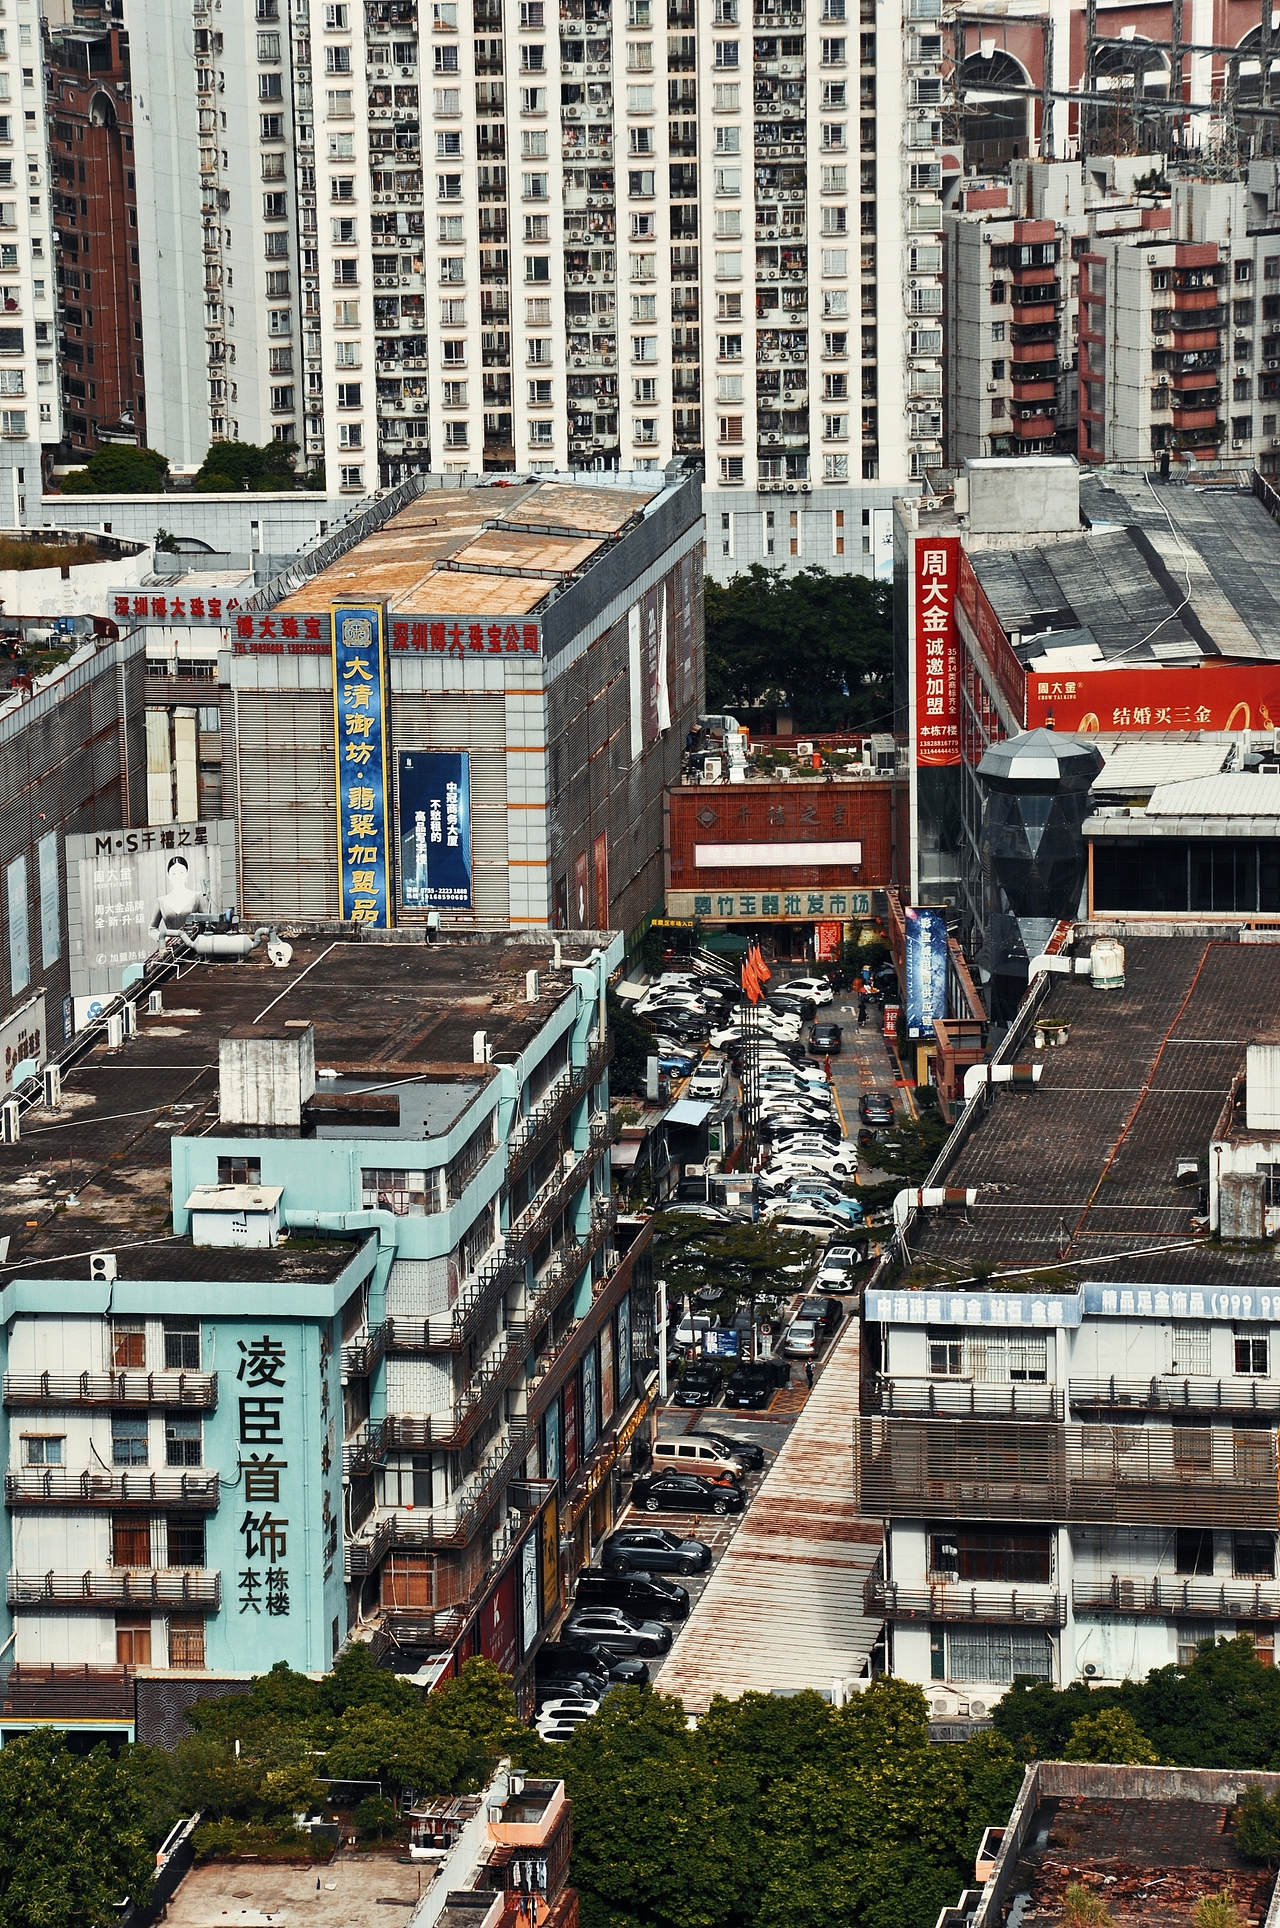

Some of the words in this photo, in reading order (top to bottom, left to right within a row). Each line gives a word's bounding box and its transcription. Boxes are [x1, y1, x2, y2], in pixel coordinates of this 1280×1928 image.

[921, 550, 949, 632] 周大金
[114, 596, 239, 618] 深圳博大珠宝公
[236, 615, 321, 639] 博大珠宝
[392, 622, 538, 653] 深圳博大珠宝公司
[926, 637, 944, 715] 诚邀加盟
[1038, 681, 1076, 694] 周大金
[1112, 705, 1212, 726] 结婚买三金
[920, 725, 957, 736] 本栋7楼
[430, 799, 442, 843] 不愁租的
[446, 781, 458, 847] 中冠商务大厦
[732, 803, 847, 826] 千禧之星
[707, 844, 851, 859] 聚宝新零售服务基地
[94, 868, 132, 883] 周大金
[94, 900, 145, 916] 周大金品牌
[694, 894, 870, 915] 翠竹玉器批发市场
[991, 1299, 1022, 1318] 钻石
[1102, 1290, 1204, 1311] 精品足金饰品
[237, 1335, 288, 1563] 凌臣首饰
